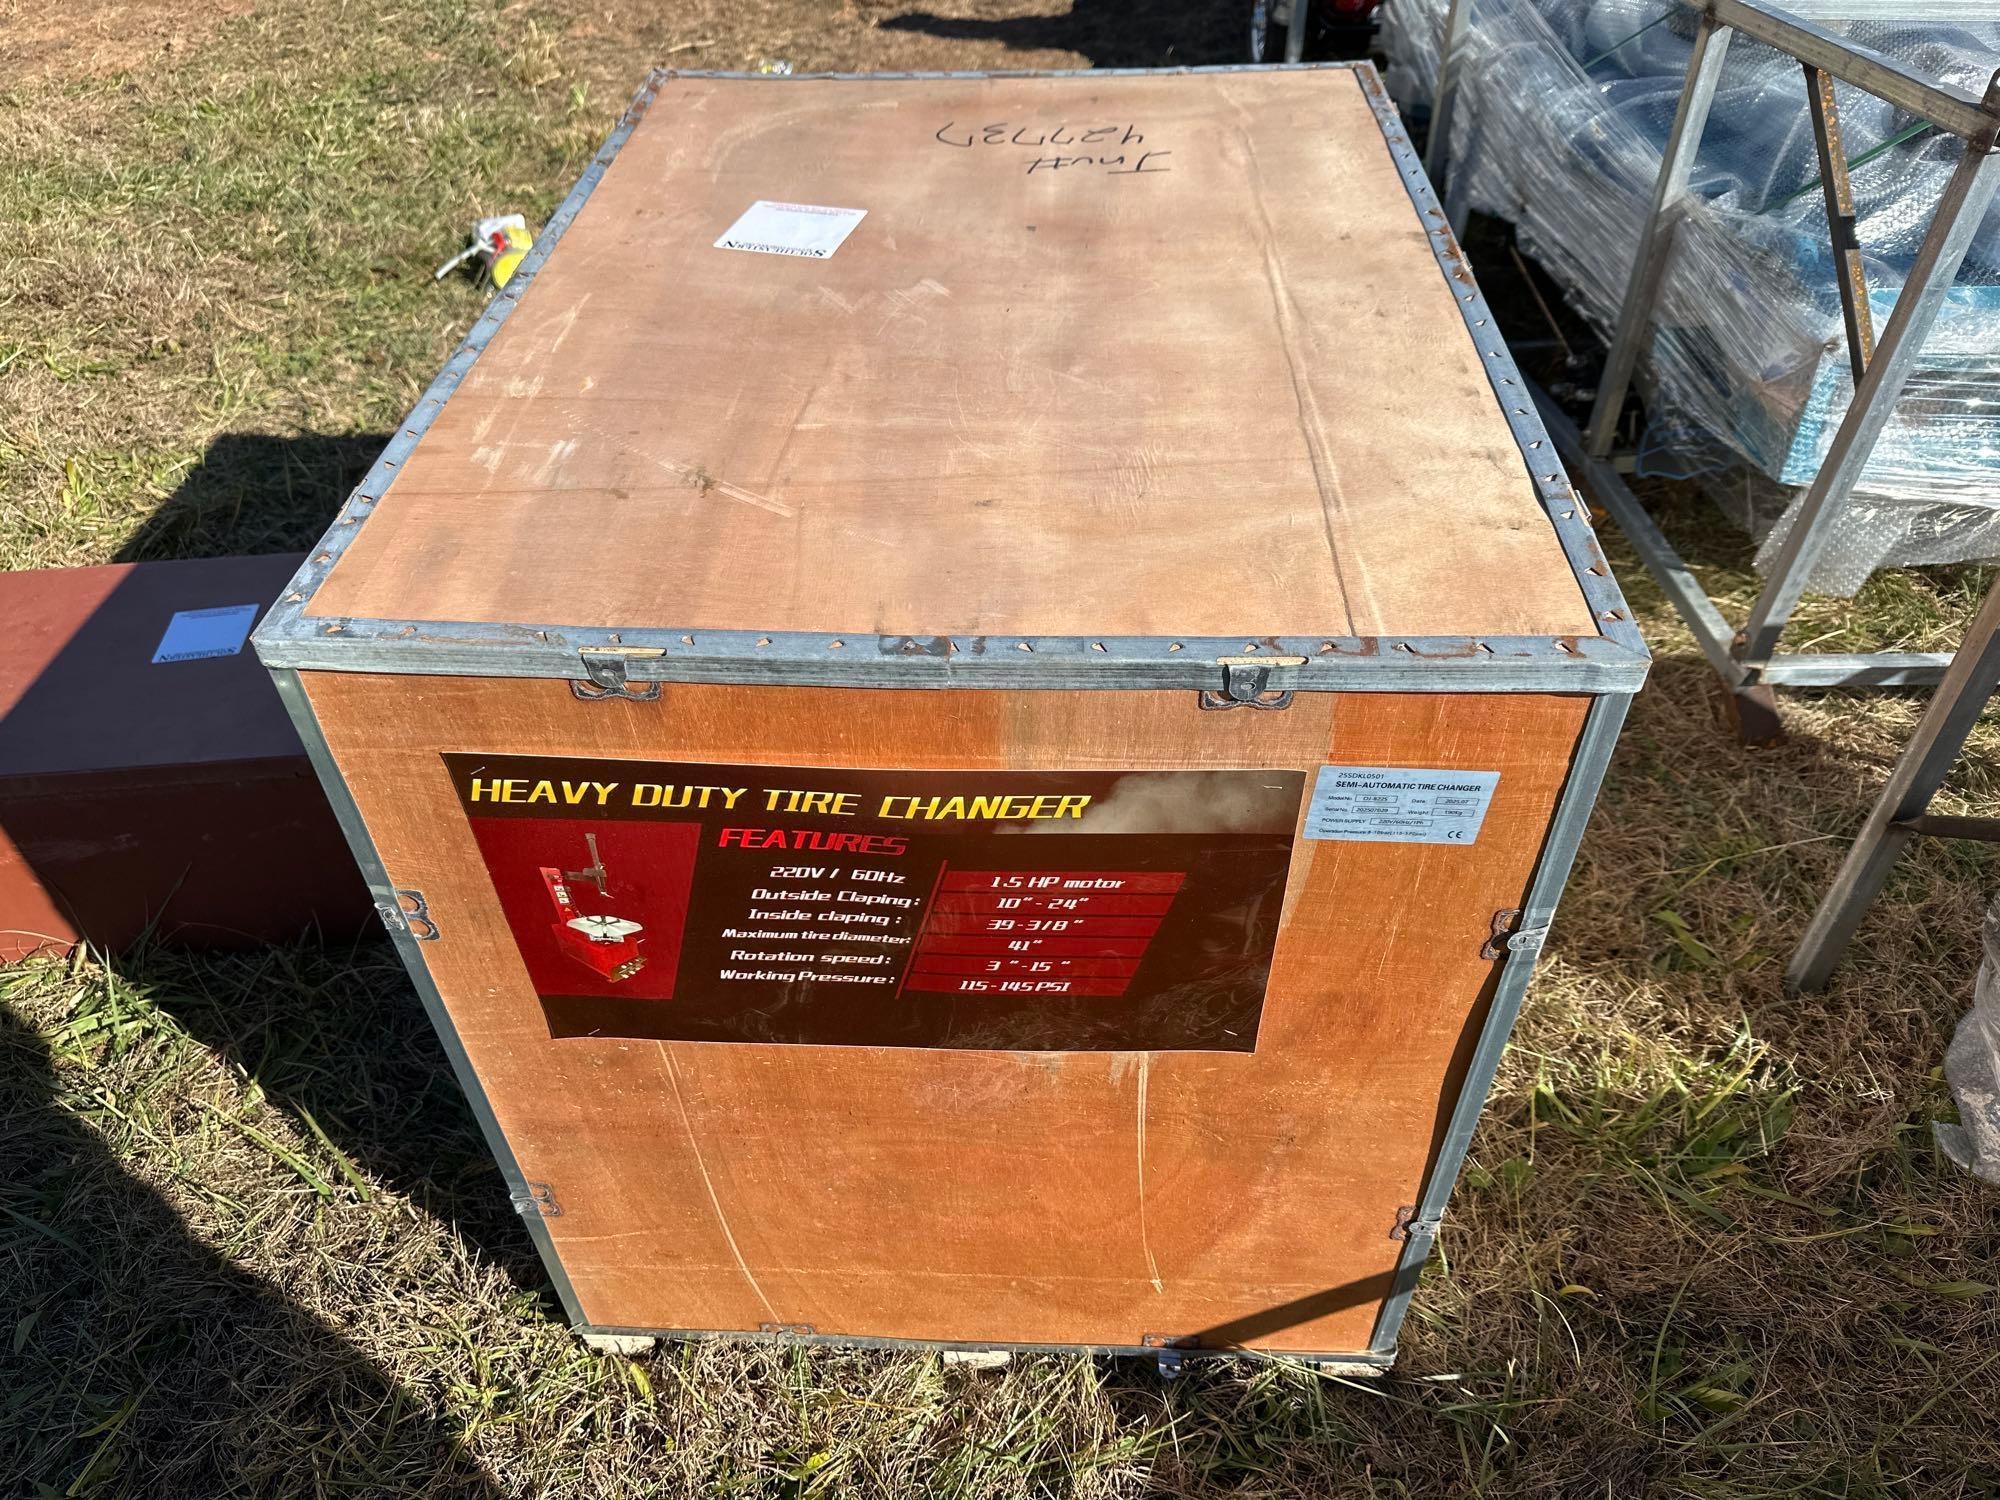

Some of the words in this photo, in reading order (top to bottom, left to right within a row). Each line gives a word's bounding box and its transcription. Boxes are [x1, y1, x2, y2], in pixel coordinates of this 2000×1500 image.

[1335, 780, 1416, 790] SEMI-AUTOMATIC
[1417, 783, 1437, 791] TIRE
[1437, 783, 1482, 792] CHANGER
[470, 778, 619, 806] HEAVY
[631, 783, 748, 810] DUTY
[762, 788, 862, 816] TIRE
[878, 795, 1092, 820] CHANGER
[718, 828, 909, 856] FEATURES
[769, 866, 824, 880] 220V
[850, 869, 906, 885] 60Hz
[989, 876, 1023, 890] 1.5
[1028, 876, 1061, 889] HP
[1063, 877, 1126, 890] motor
[751, 889, 832, 904] Outside
[837, 891, 920, 909] Claping:
[748, 908, 812, 922] Inside
[721, 928, 800, 940] Maximum
[801, 930, 830, 941] tire
[831, 931, 911, 944] diameter:
[730, 950, 815, 964] Rotation
[820, 954, 891, 967] speed:
[719, 969, 795, 983] Working
[1035, 981, 1071, 993] PSI
